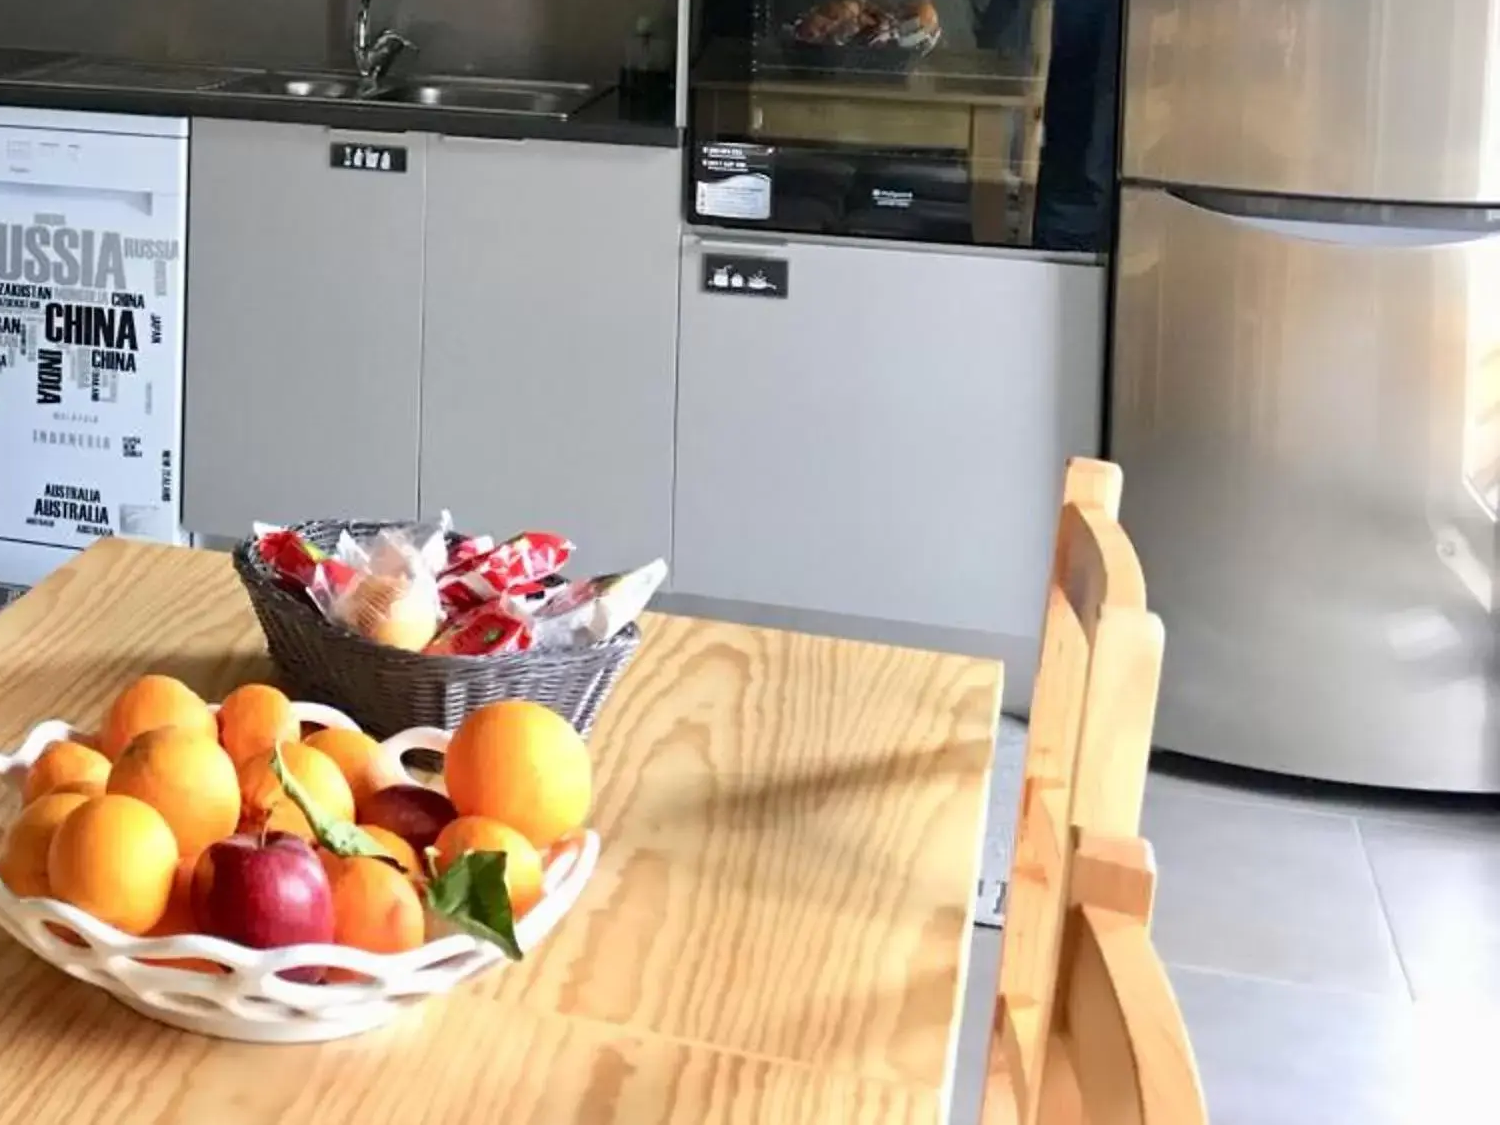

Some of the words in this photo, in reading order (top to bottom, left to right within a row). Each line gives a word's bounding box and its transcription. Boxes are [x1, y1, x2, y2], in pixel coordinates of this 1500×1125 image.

[124, 237, 179, 261] RUSSIA
[111, 292, 145, 309] CHINA
[45, 302, 138, 352] CHINA
[91, 350, 137, 373] CHINA
[37, 349, 63, 404] INDIA
[44, 483, 101, 504] AUSTRALIA
[34, 498, 109, 525] AUSTRALIA
